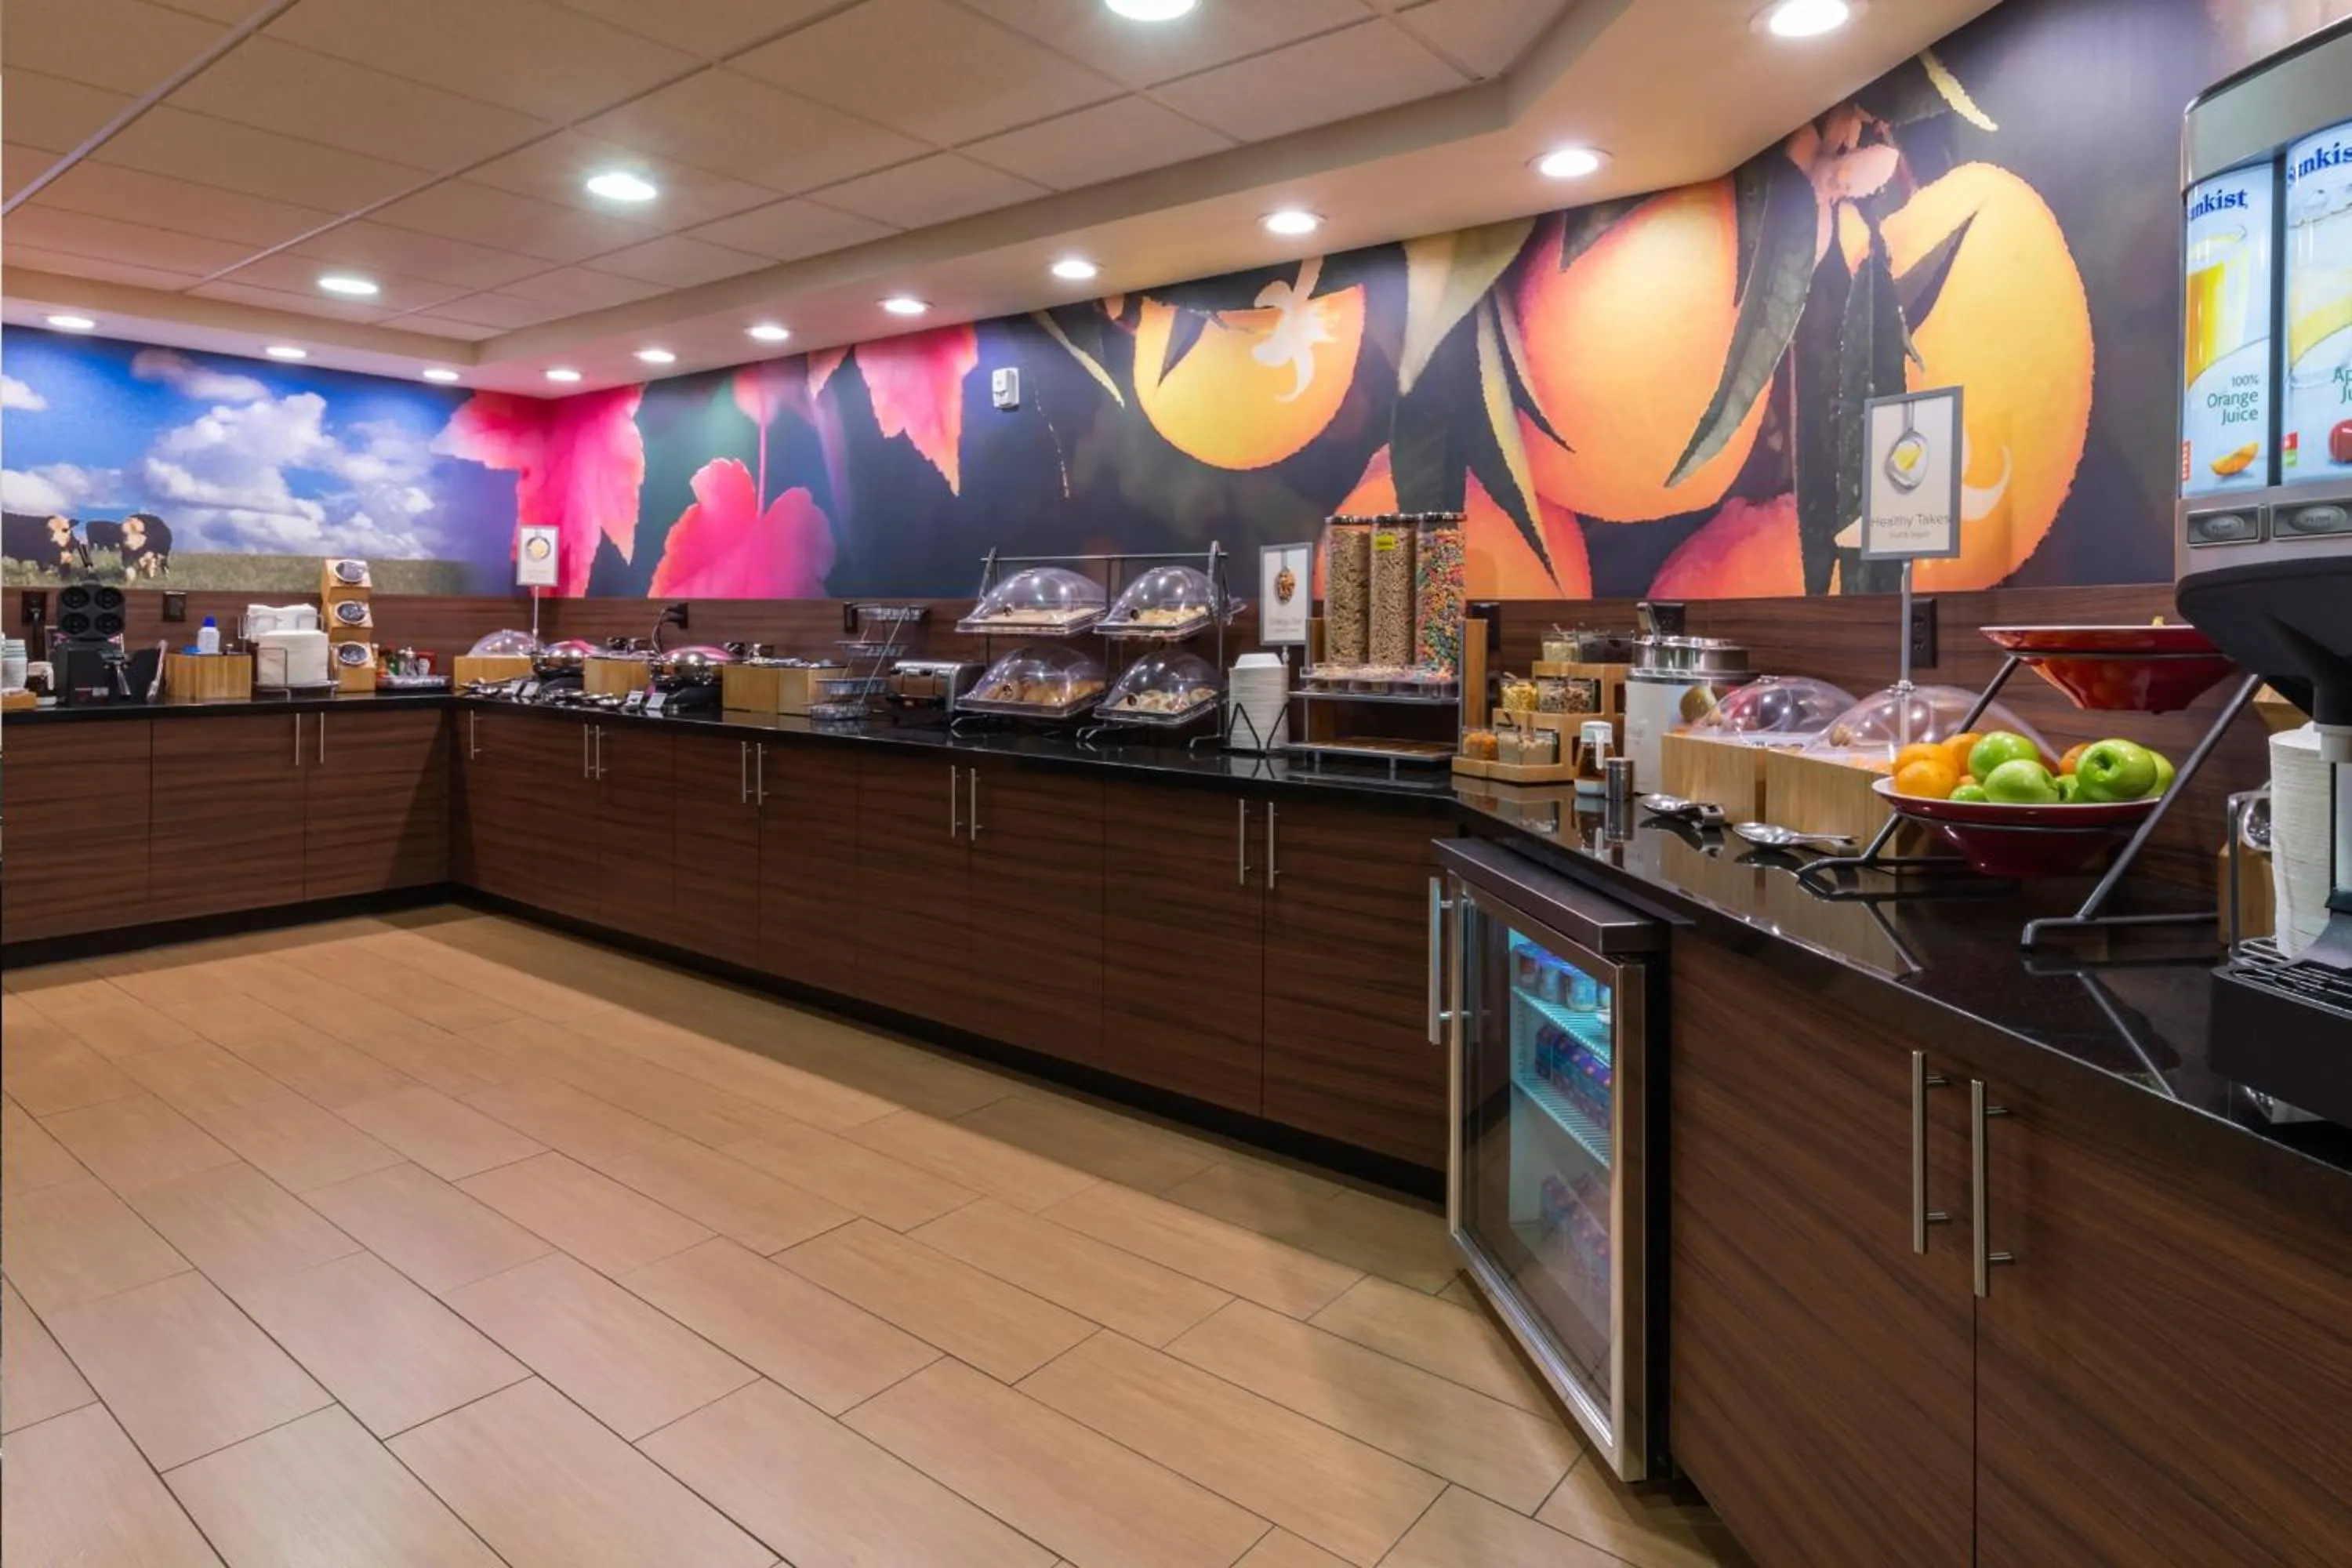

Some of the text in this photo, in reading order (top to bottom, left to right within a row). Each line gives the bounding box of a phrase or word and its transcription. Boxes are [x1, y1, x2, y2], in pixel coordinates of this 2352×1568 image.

[2232, 375, 2259, 387] 100%
[2207, 391, 2259, 408] Orange
[2221, 408, 2259, 426] Juice
[1871, 514, 1914, 528] Healthy
